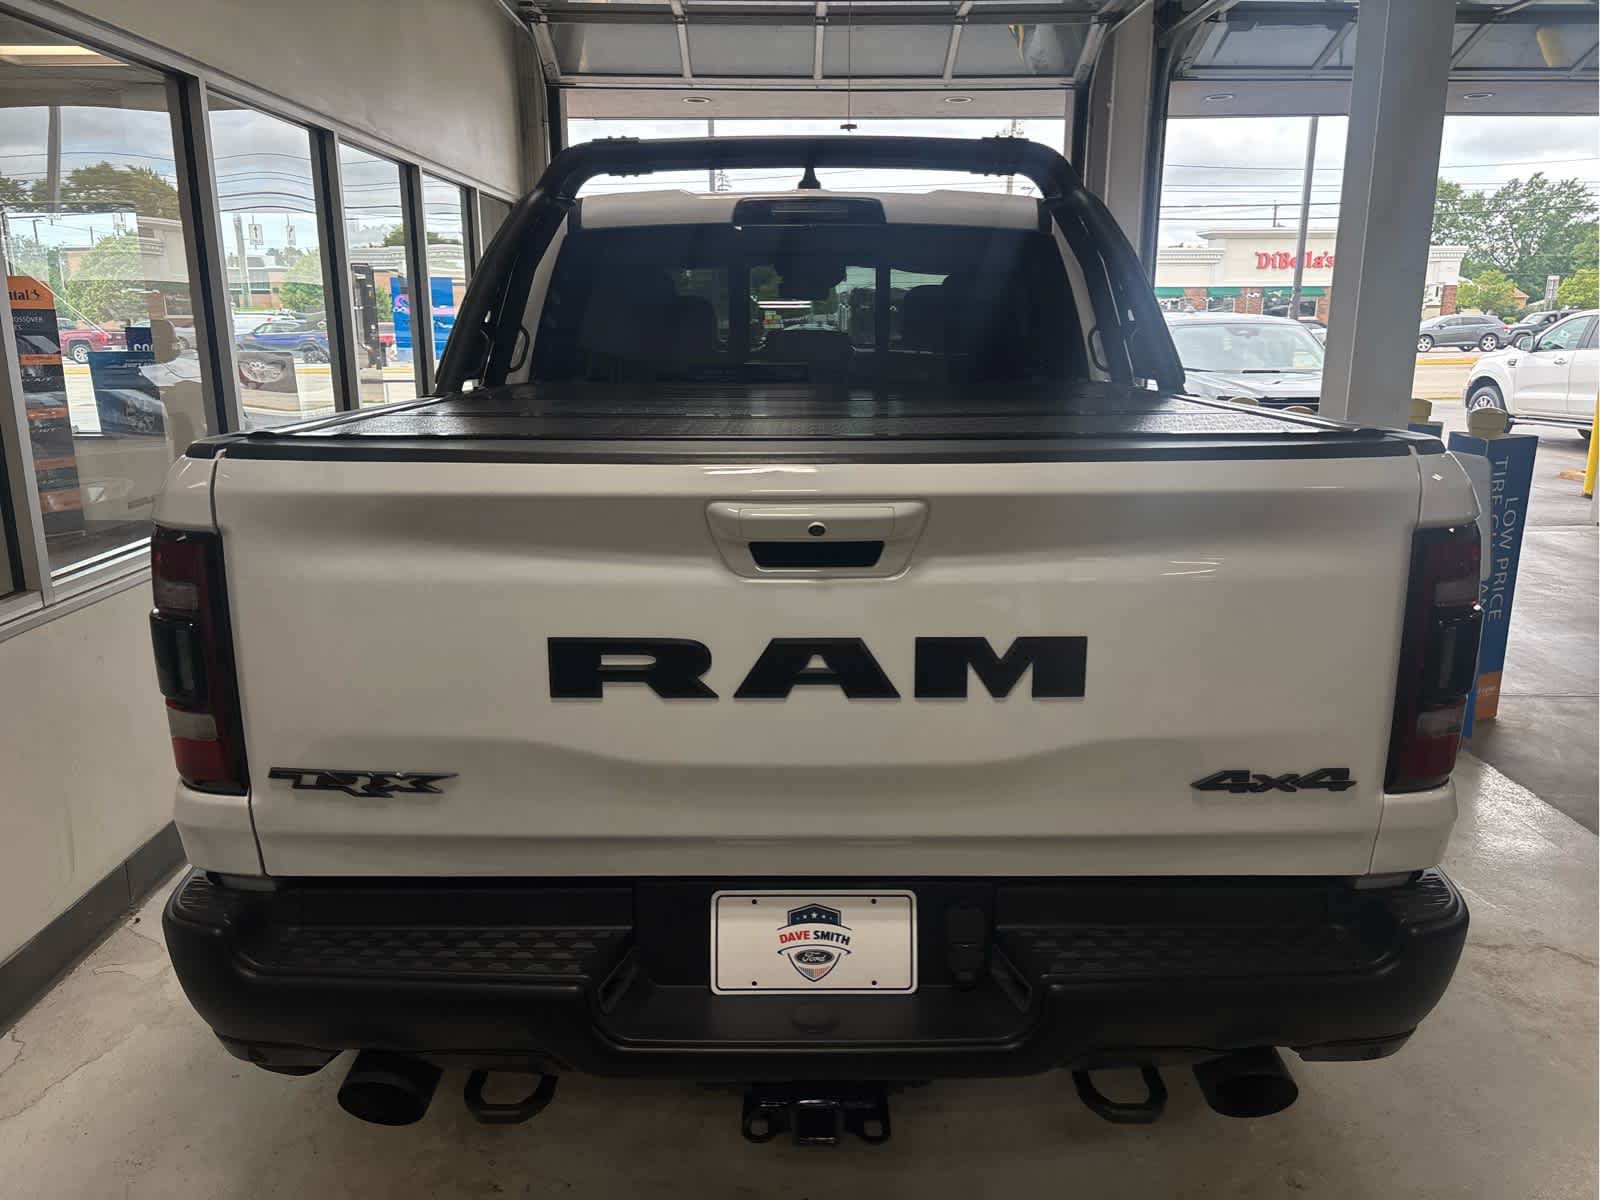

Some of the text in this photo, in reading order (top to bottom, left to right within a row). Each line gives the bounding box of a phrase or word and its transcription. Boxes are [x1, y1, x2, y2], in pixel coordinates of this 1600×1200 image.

[1254, 251, 1335, 269] DiBela's
[1491, 456, 1509, 505] TIRE
[1499, 497, 1520, 549] LOW
[1488, 557, 1510, 622] PRICE
[547, 636, 1088, 700] RAM
[268, 767, 459, 798] TRX
[1190, 768, 1357, 793] 4x4
[779, 930, 851, 945] DAVE SMITH
[799, 951, 829, 963] Ford
